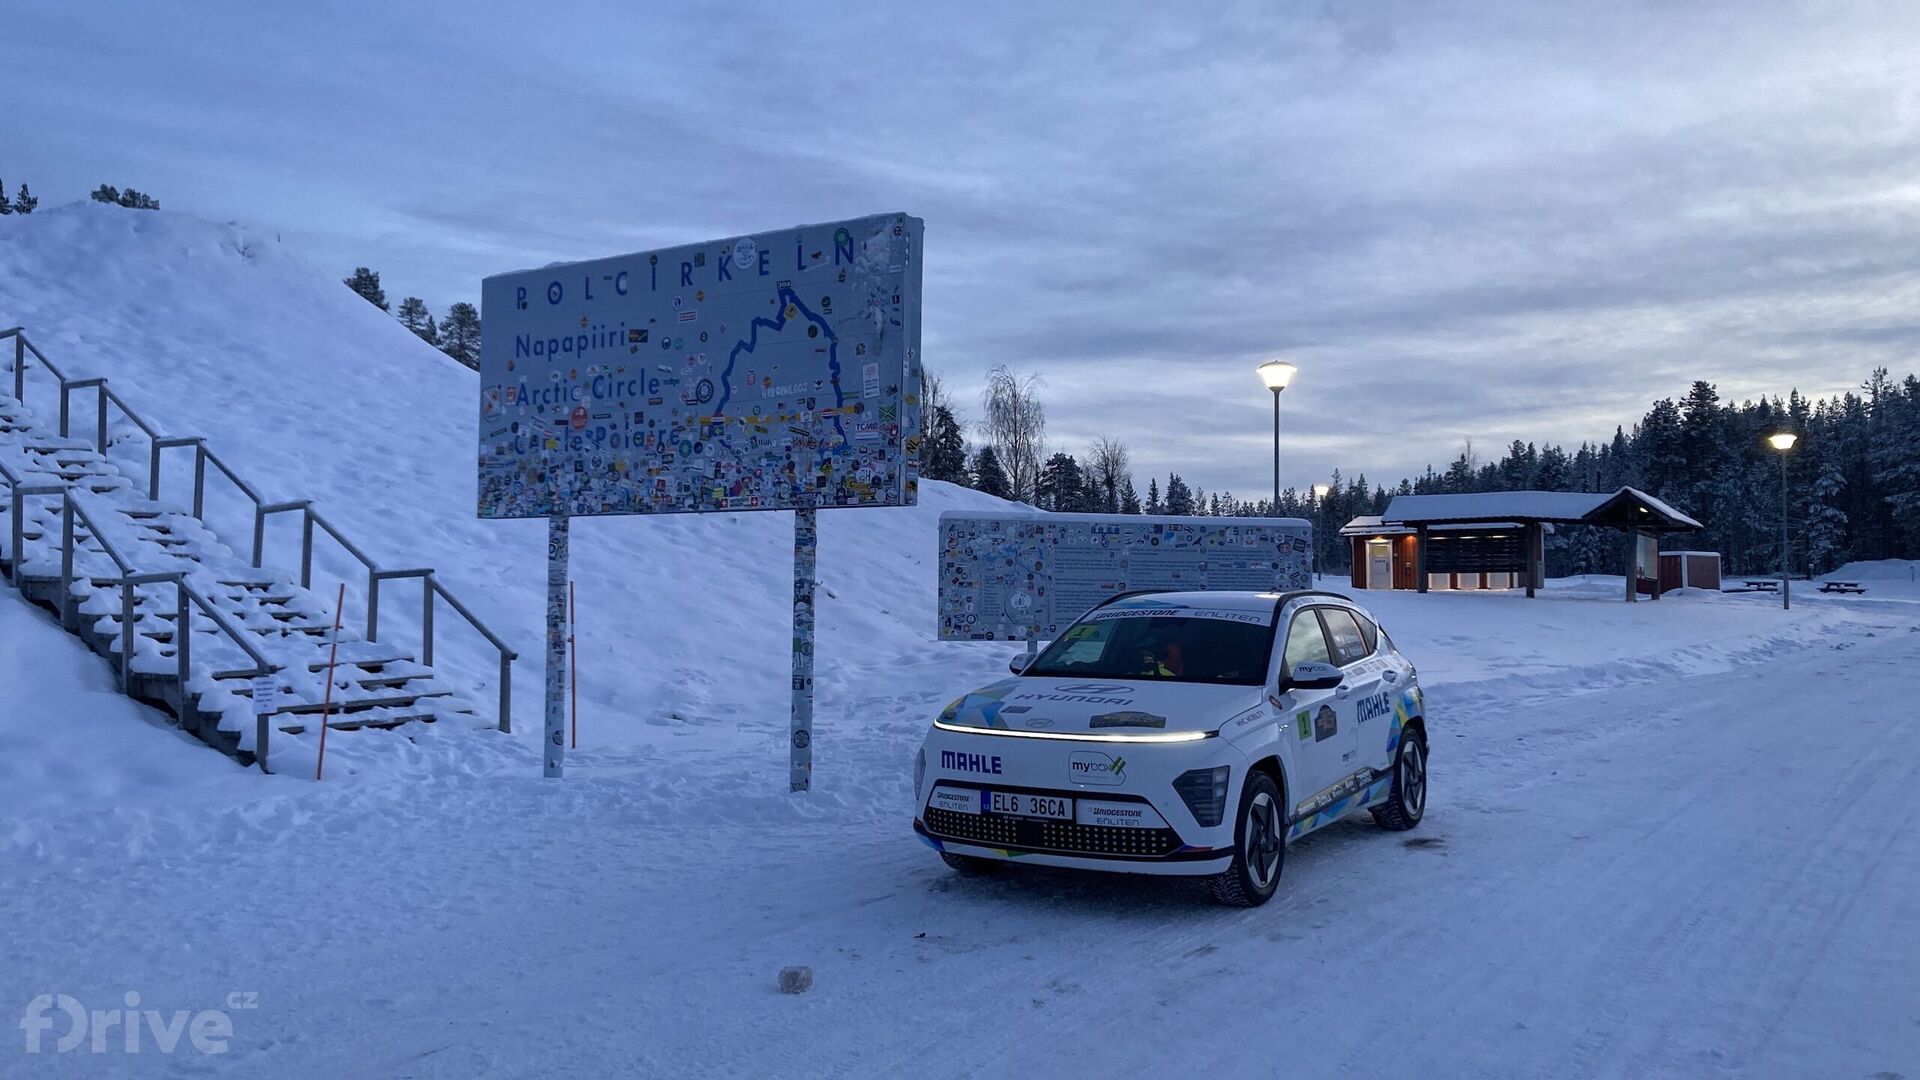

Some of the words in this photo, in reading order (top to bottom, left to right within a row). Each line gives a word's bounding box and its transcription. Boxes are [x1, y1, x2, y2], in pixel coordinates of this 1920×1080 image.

[515, 235, 854, 311] POLCIRKELN
[515, 321, 626, 362] Napapiiri
[516, 378, 583, 406] Arctic
[592, 368, 660, 400] Circle
[514, 426, 583, 455] Cerle
[595, 418, 681, 450] Polare
[1093, 609, 1181, 620] BRIDGESTONE
[1194, 610, 1261, 623] ENLITEN
[1014, 694, 1134, 706] HYUNDAI
[1356, 691, 1391, 724] MAHLE
[941, 750, 1003, 775] MAHLE
[993, 794, 1019, 812] EL6
[1030, 798, 1066, 817] 36CA
[1092, 807, 1143, 818] BRIDGESTONE
[1096, 817, 1140, 827] ENLITEN
